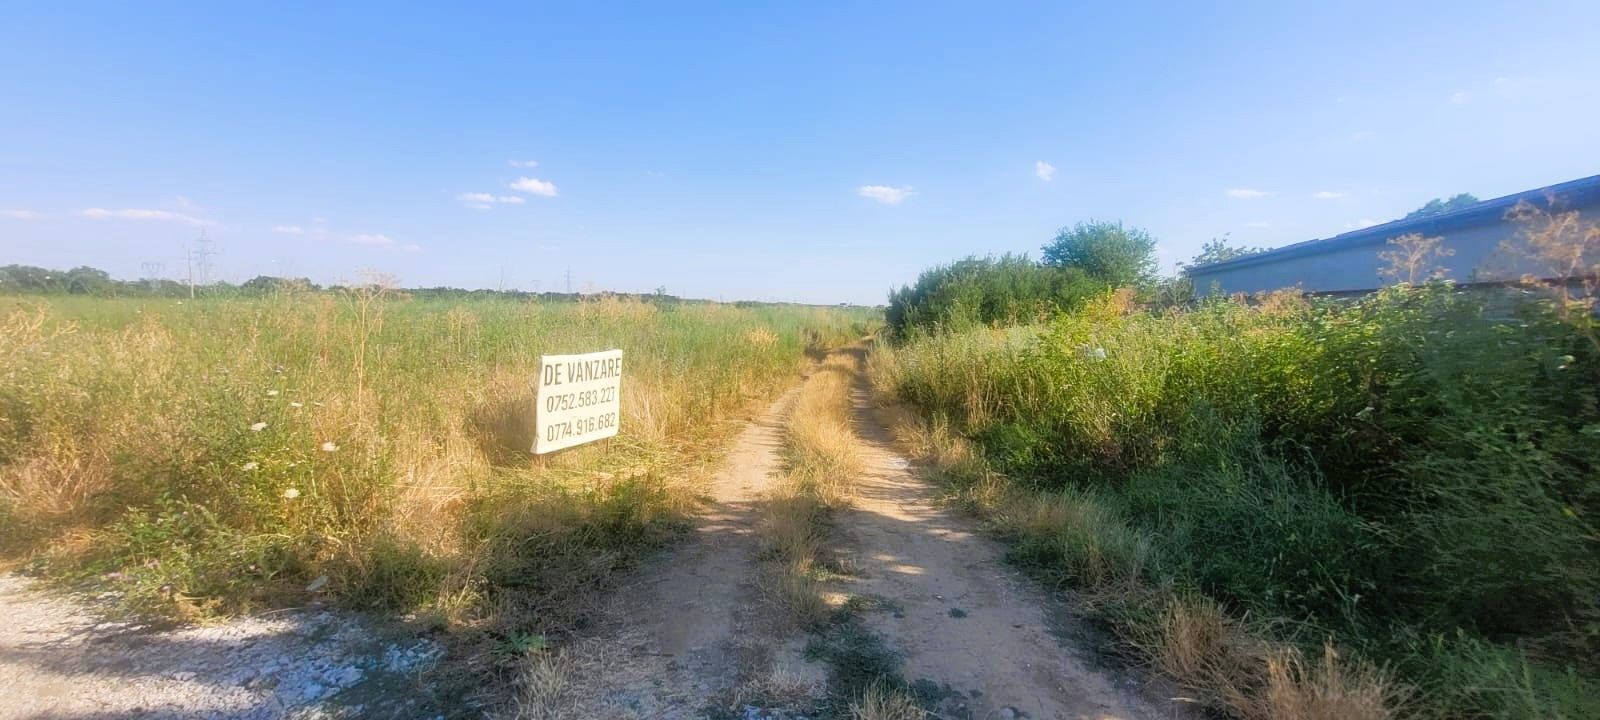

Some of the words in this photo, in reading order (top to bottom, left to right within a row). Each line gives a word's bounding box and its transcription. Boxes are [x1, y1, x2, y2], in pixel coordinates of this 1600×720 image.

[544, 363, 562, 386] DE
[546, 386, 615, 413] 0752.583.227
[547, 412, 616, 442] 0774.916.682
